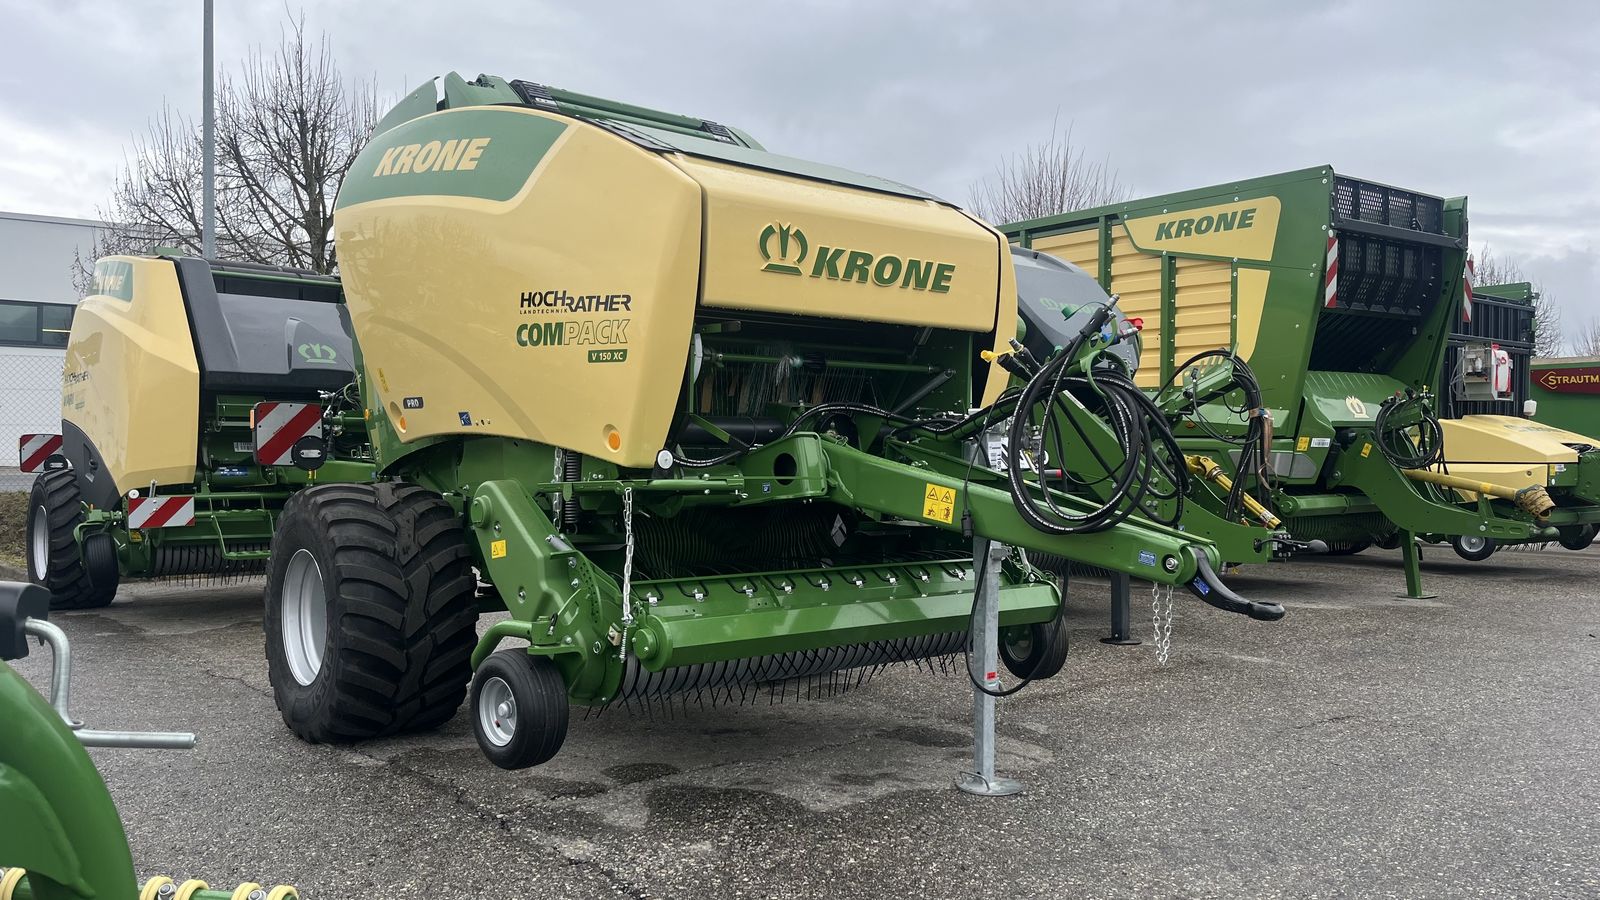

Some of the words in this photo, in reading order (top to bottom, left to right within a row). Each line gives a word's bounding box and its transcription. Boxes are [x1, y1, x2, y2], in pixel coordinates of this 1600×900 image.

[373, 138, 491, 177] KRONE
[1155, 208, 1257, 241] KRONE
[809, 246, 956, 293] KRONE
[520, 290, 632, 313] HOCHRATHER
[516, 319, 631, 347] COMPACK
[591, 353, 598, 361] V
[599, 352, 611, 361] 150
[613, 351, 624, 360] XC
[406, 398, 420, 408] PRO
